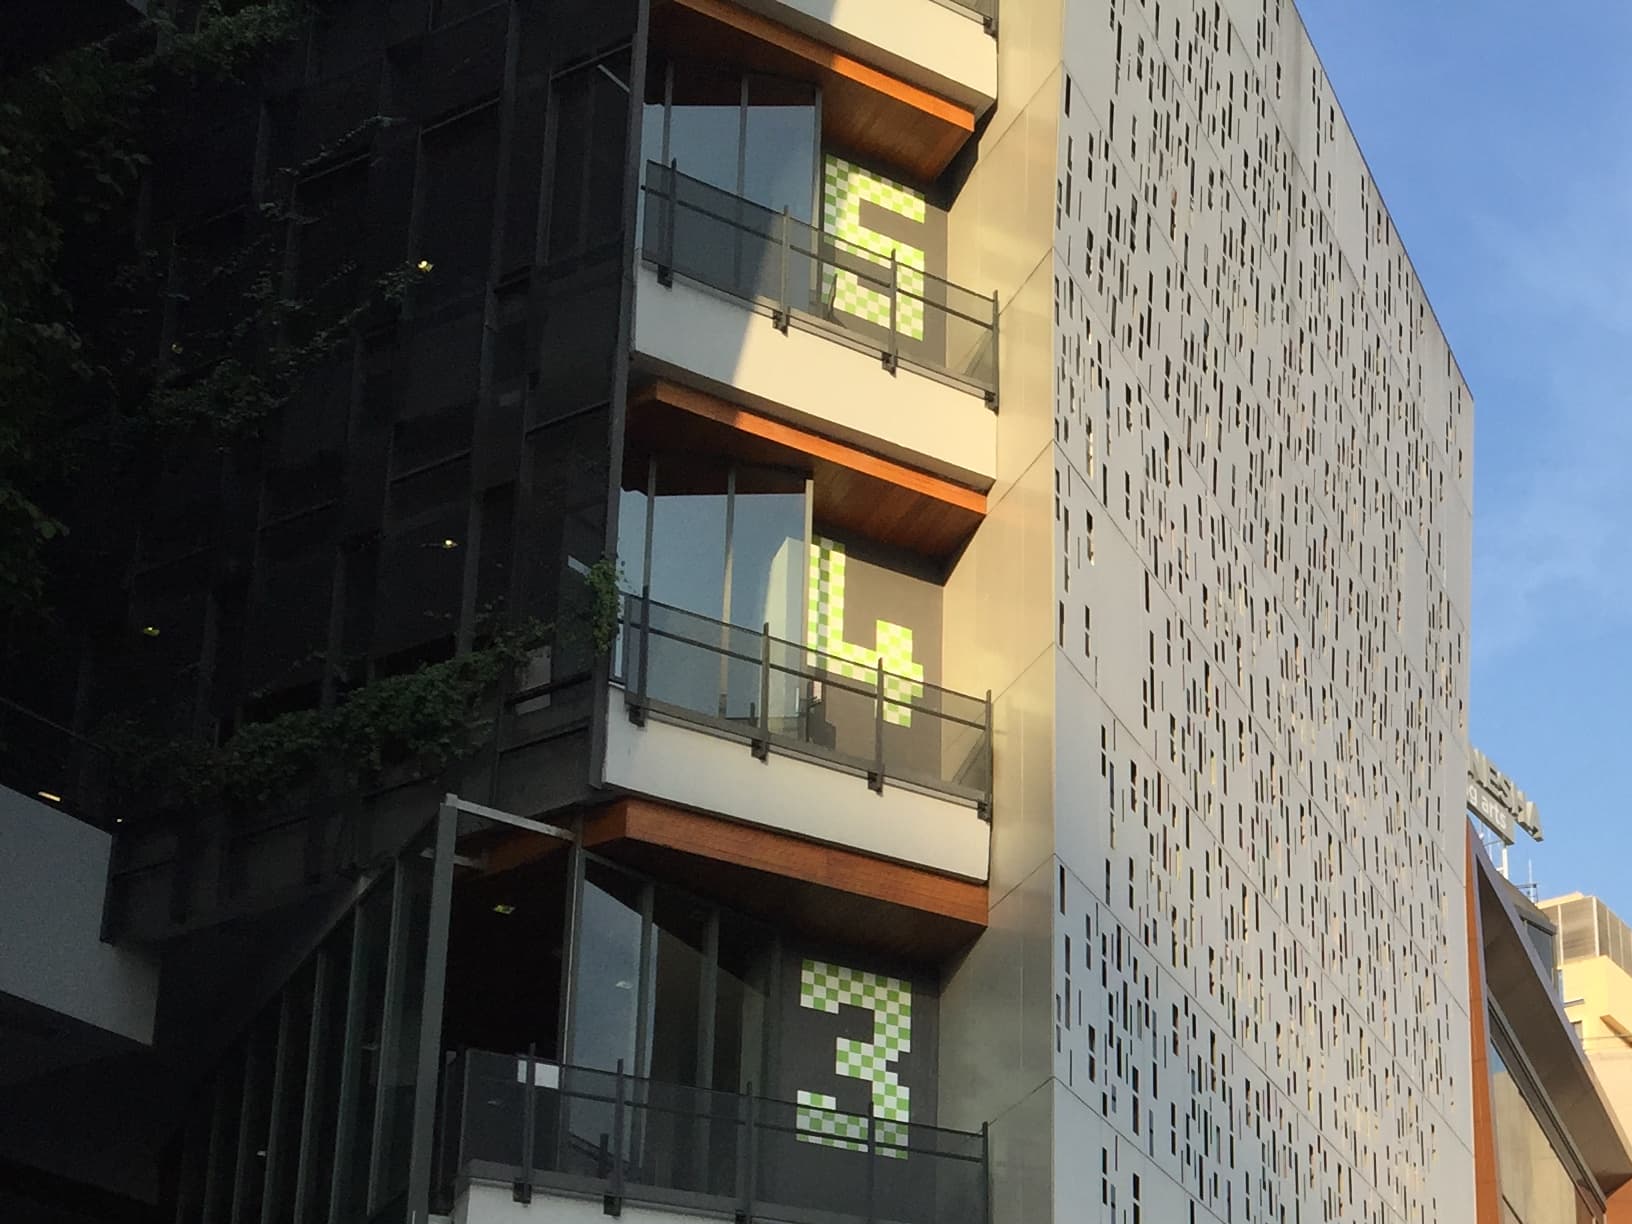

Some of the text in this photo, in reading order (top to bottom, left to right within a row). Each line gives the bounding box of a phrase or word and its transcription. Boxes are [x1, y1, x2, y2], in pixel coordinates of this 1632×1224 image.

[823, 152, 925, 342] 5
[807, 534, 925, 729] 4
[1480, 795, 1507, 830] arts
[795, 958, 913, 1160] 3
